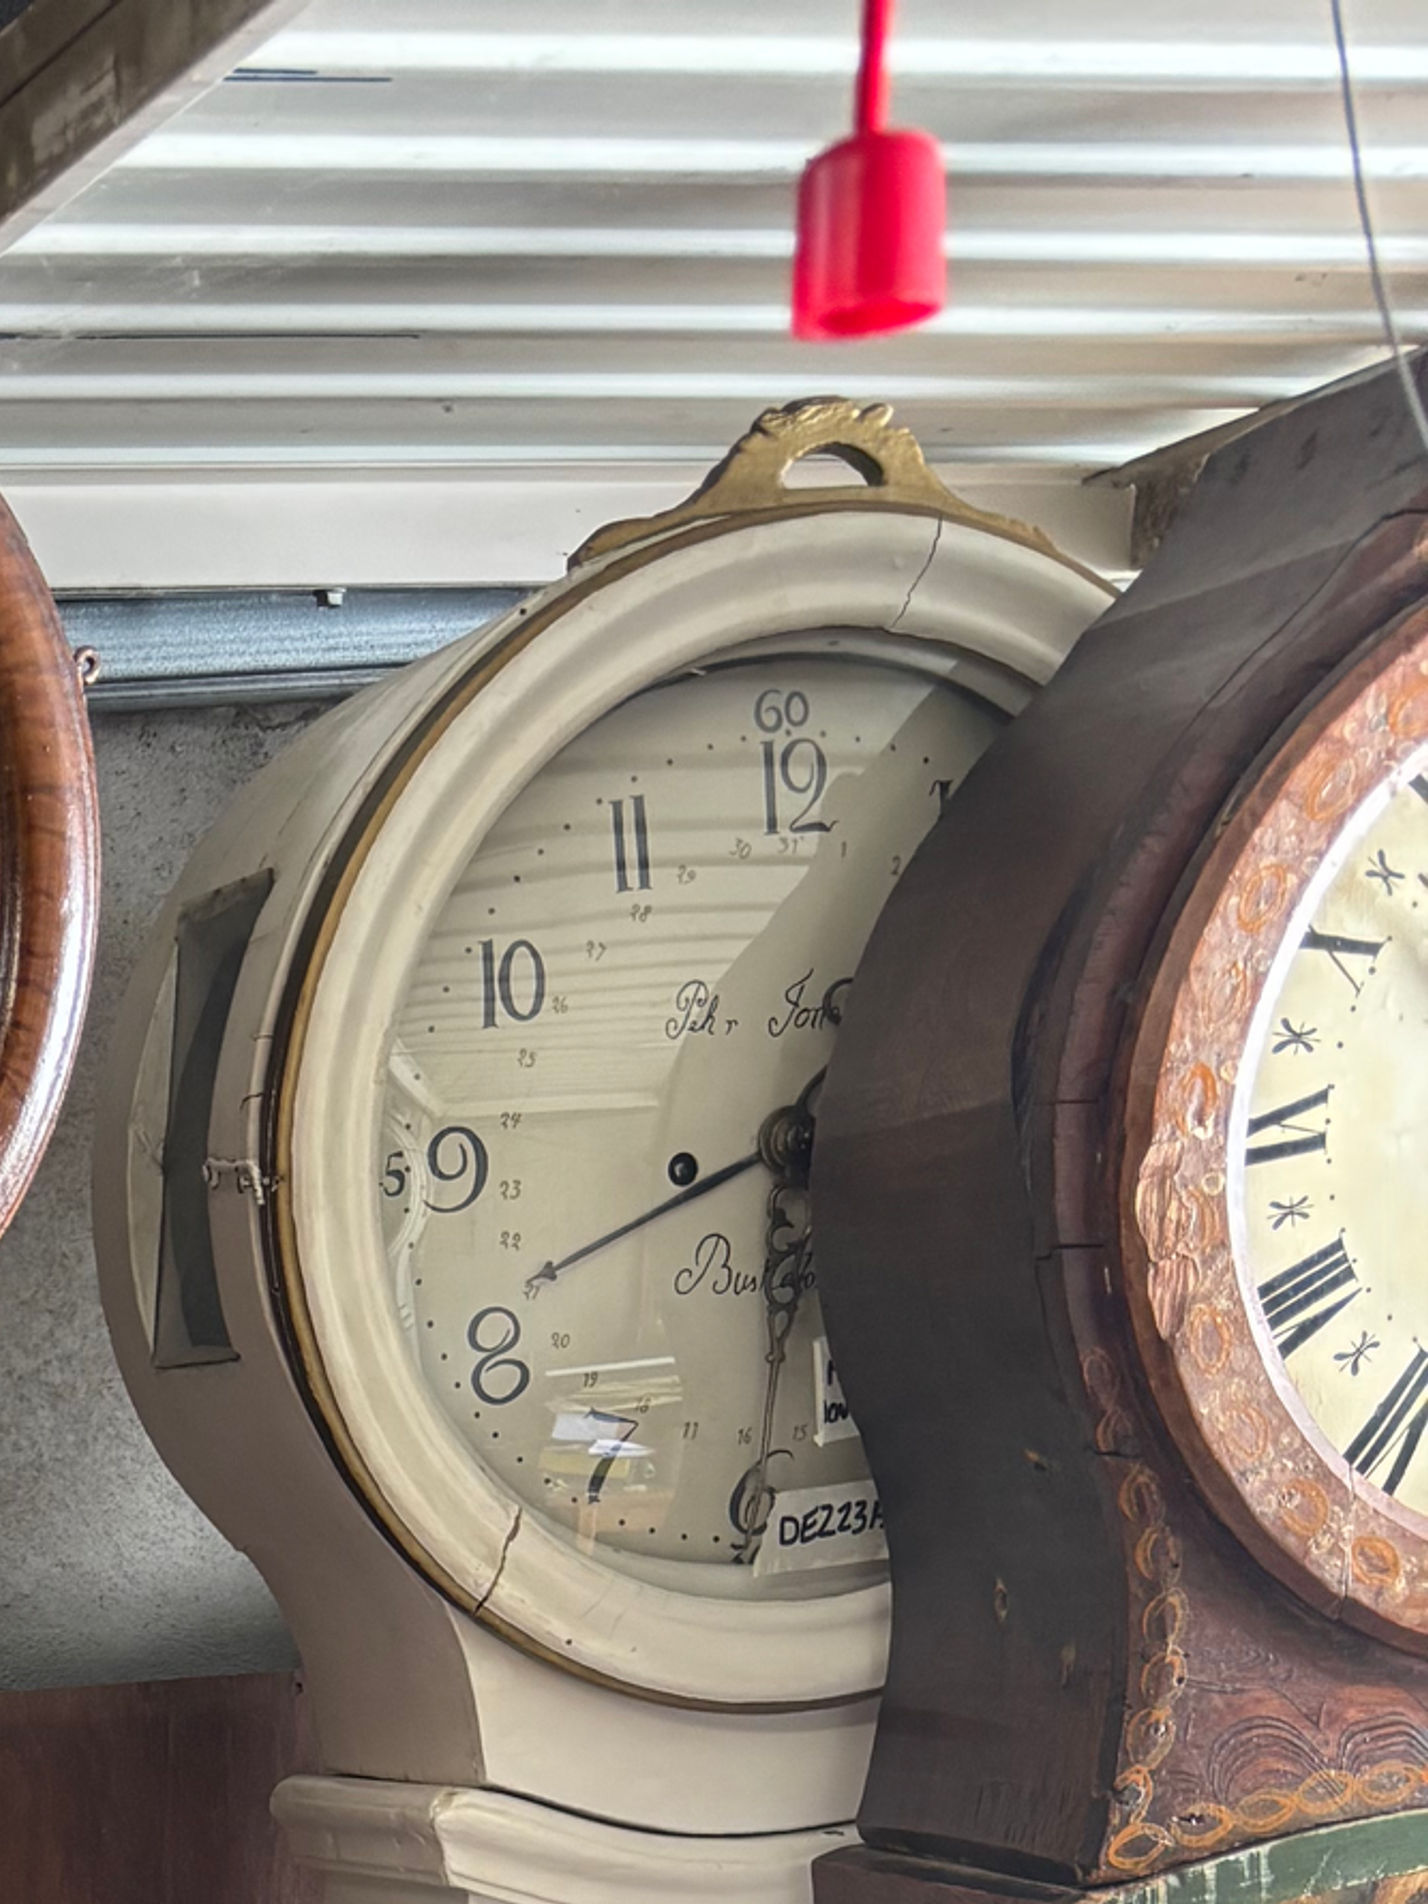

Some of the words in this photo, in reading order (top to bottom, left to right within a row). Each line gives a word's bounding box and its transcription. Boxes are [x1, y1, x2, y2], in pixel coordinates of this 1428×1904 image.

[754, 688, 810, 733] 60
[759, 737, 840, 836] 12
[607, 793, 653, 893] 11
[477, 938, 546, 1030] 10
[422, 1125, 489, 1213] 9
[466, 1306, 531, 1406] 8
[584, 1407, 640, 1505] 7
